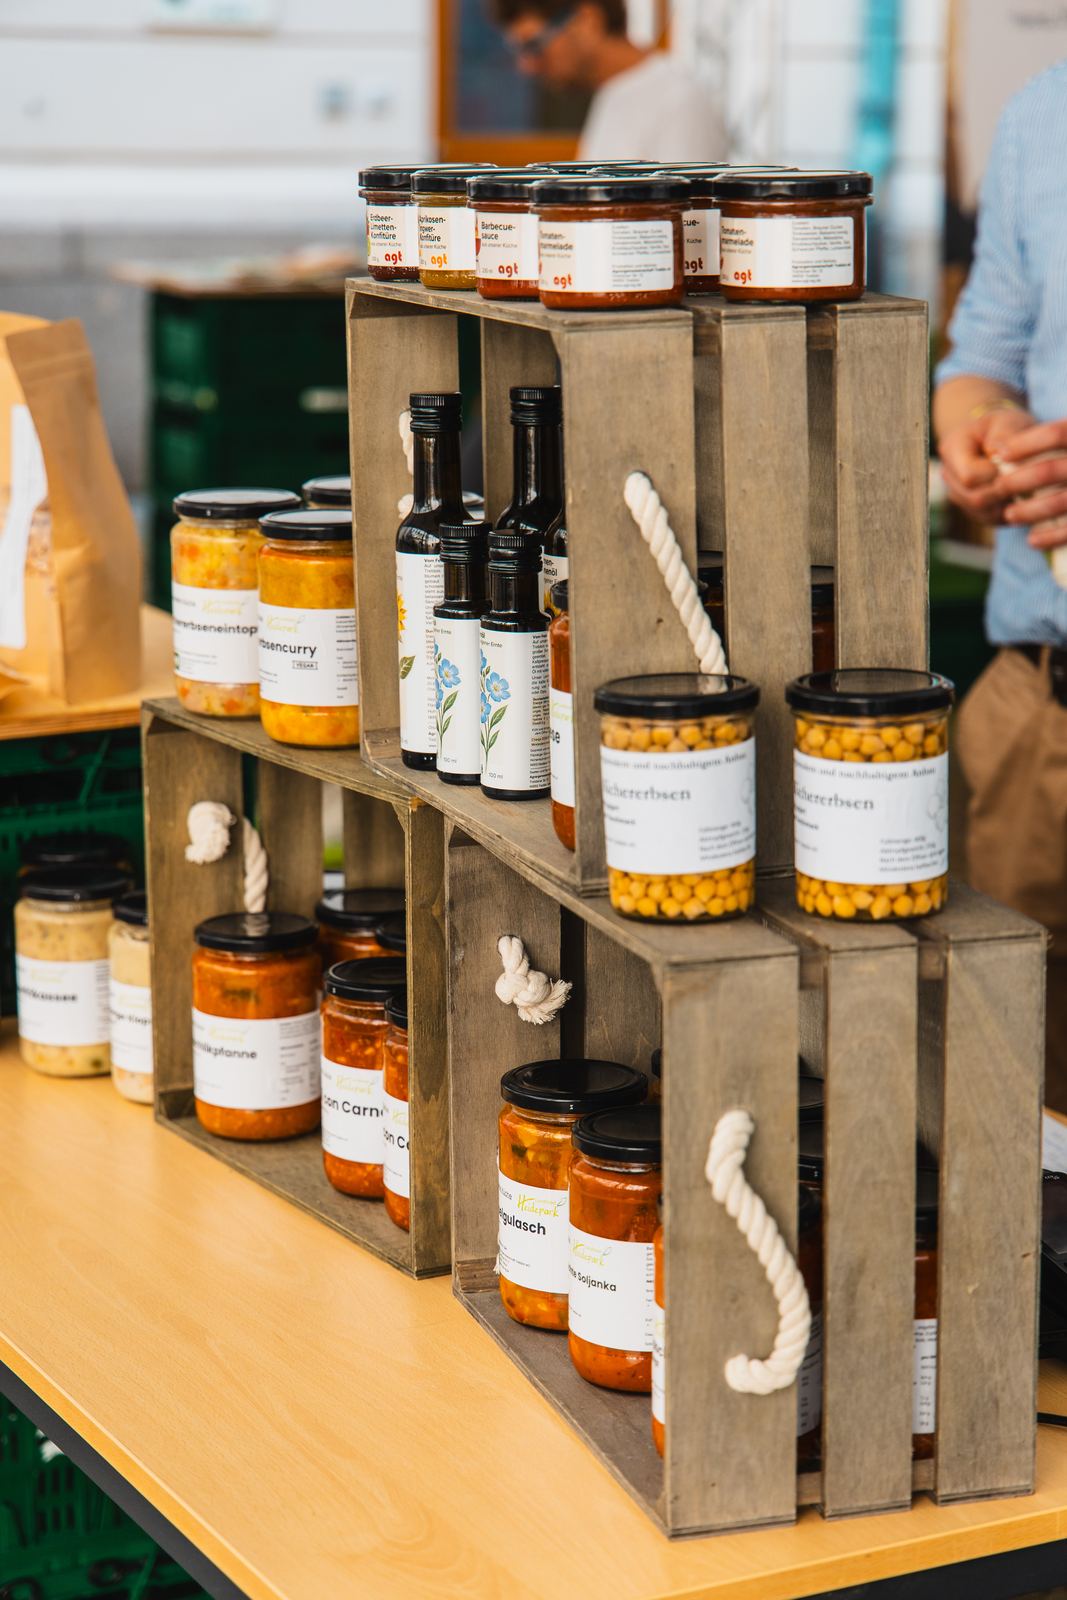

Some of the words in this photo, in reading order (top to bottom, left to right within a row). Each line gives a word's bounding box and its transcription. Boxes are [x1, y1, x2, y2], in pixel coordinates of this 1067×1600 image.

[481, 221, 516, 231] Barbecue-
[481, 232, 499, 240] sauce
[384, 251, 402, 265] agt
[431, 253, 448, 268] agt
[498, 262, 519, 278] agt
[734, 269, 752, 284] agt
[553, 273, 572, 288] agt
[517, 1193, 559, 1217] Heidepark
[577, 1271, 618, 1292] Soljanka
